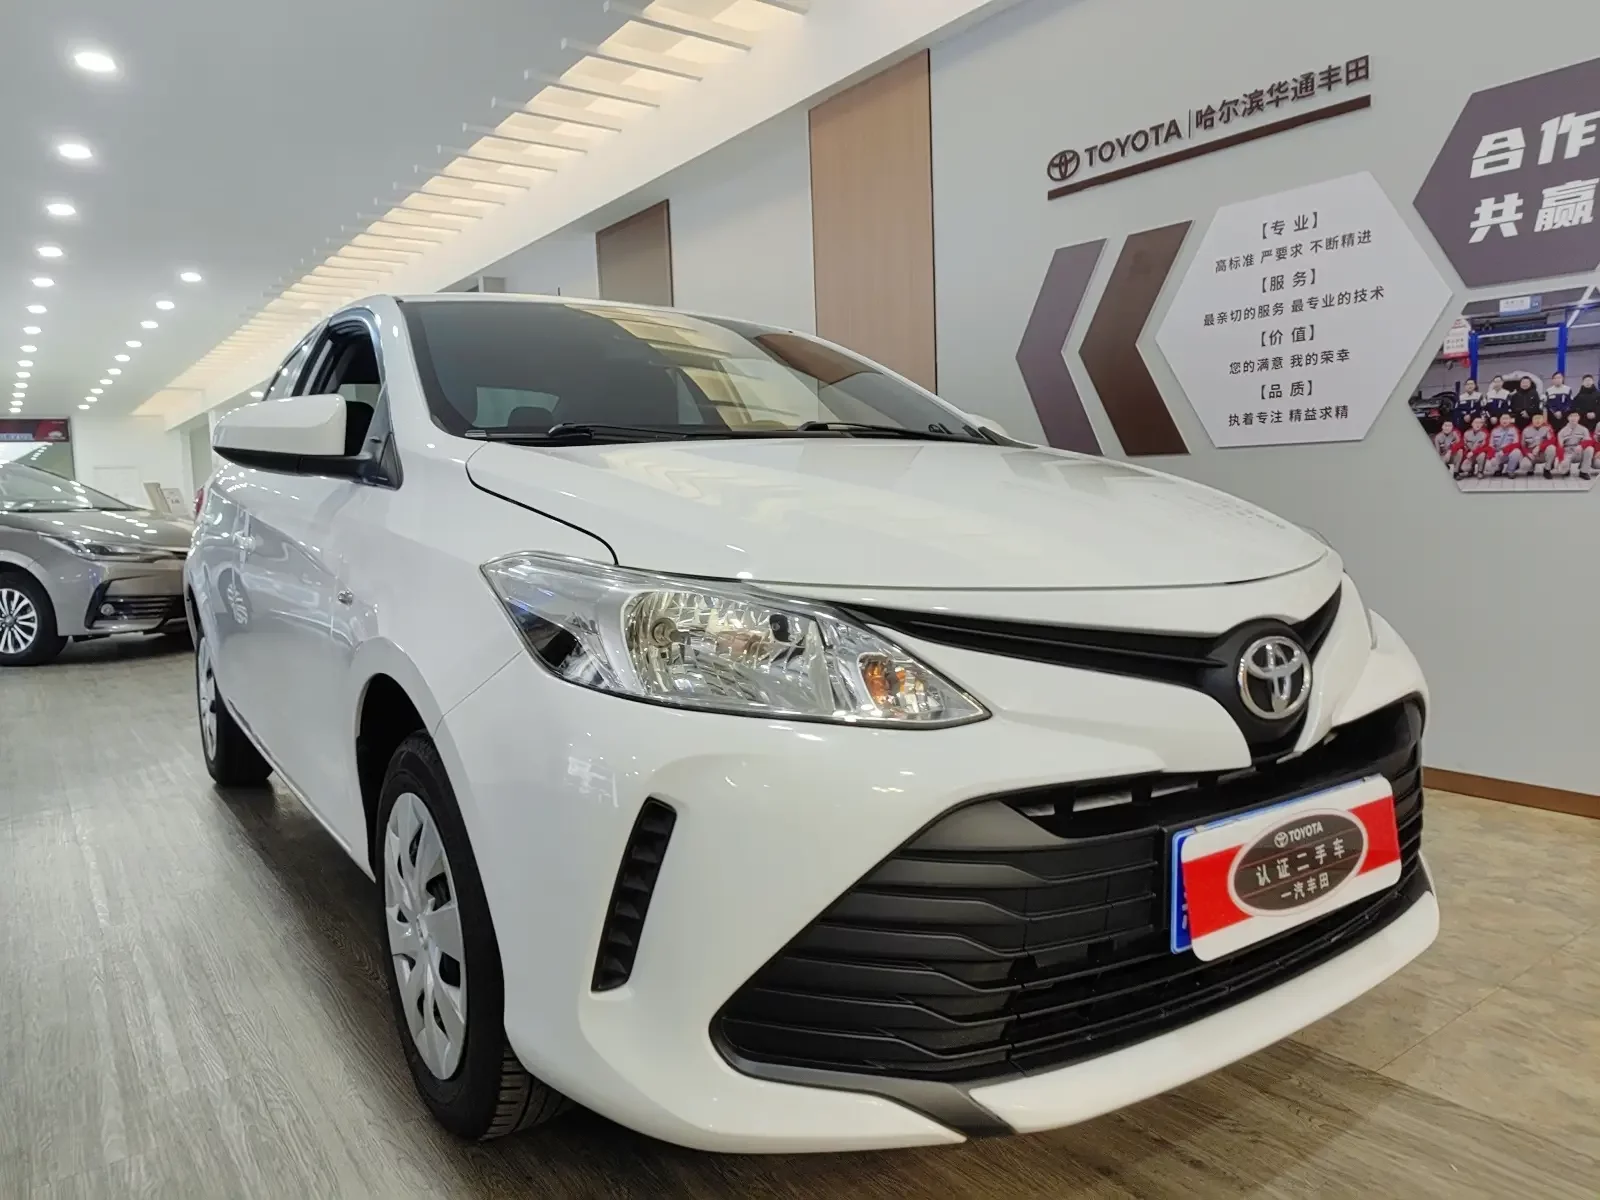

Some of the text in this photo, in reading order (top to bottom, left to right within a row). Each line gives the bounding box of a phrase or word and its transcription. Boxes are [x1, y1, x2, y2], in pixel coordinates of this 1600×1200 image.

[1195, 55, 1369, 131] 哈尔滨华通丰田
[1085, 119, 1182, 167] TOYOTA
[1470, 111, 1600, 178] 合作
[1468, 178, 1600, 244] 共赢
[1215, 229, 1372, 273] 高标准 严要求 不断精进
[1203, 285, 1385, 327] 最亲切的服务 最专业的技术
[1229, 349, 1350, 375] 您的满意 我的荣幸
[1228, 405, 1348, 427] 执着专注 精益求精
[1288, 821, 1323, 843] TOYOTA
[1256, 838, 1345, 887] 认证二手车
[1280, 872, 1330, 900] 一汽丰田
